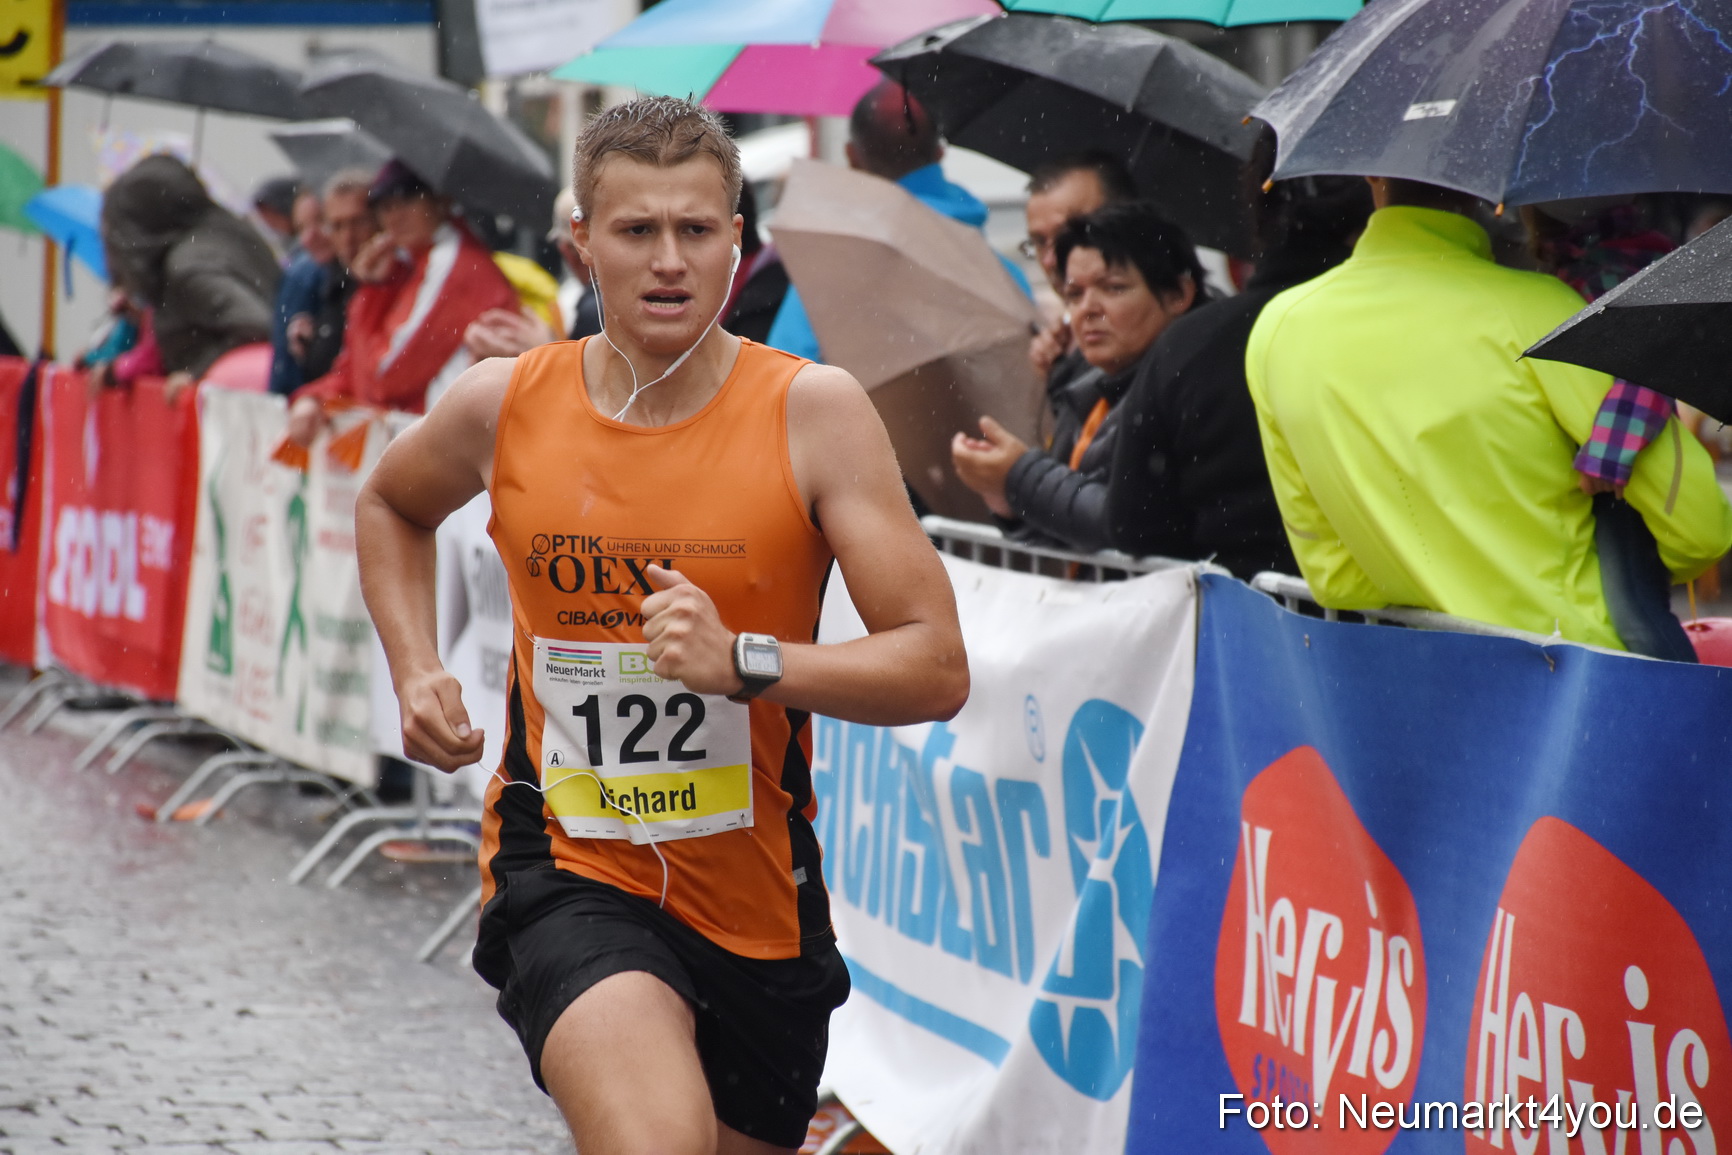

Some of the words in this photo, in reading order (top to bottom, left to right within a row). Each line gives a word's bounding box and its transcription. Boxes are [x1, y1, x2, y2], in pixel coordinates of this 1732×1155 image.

[607, 541, 650, 552] UHREN
[655, 542, 681, 552] UND
[684, 544, 746, 554] SCHMUCK
[546, 663, 606, 678] NeuerMarkt
[619, 676, 652, 684] inspired
[572, 693, 707, 766] 122
[550, 752, 560, 764] A
[1238, 820, 1415, 1118] Hervis
